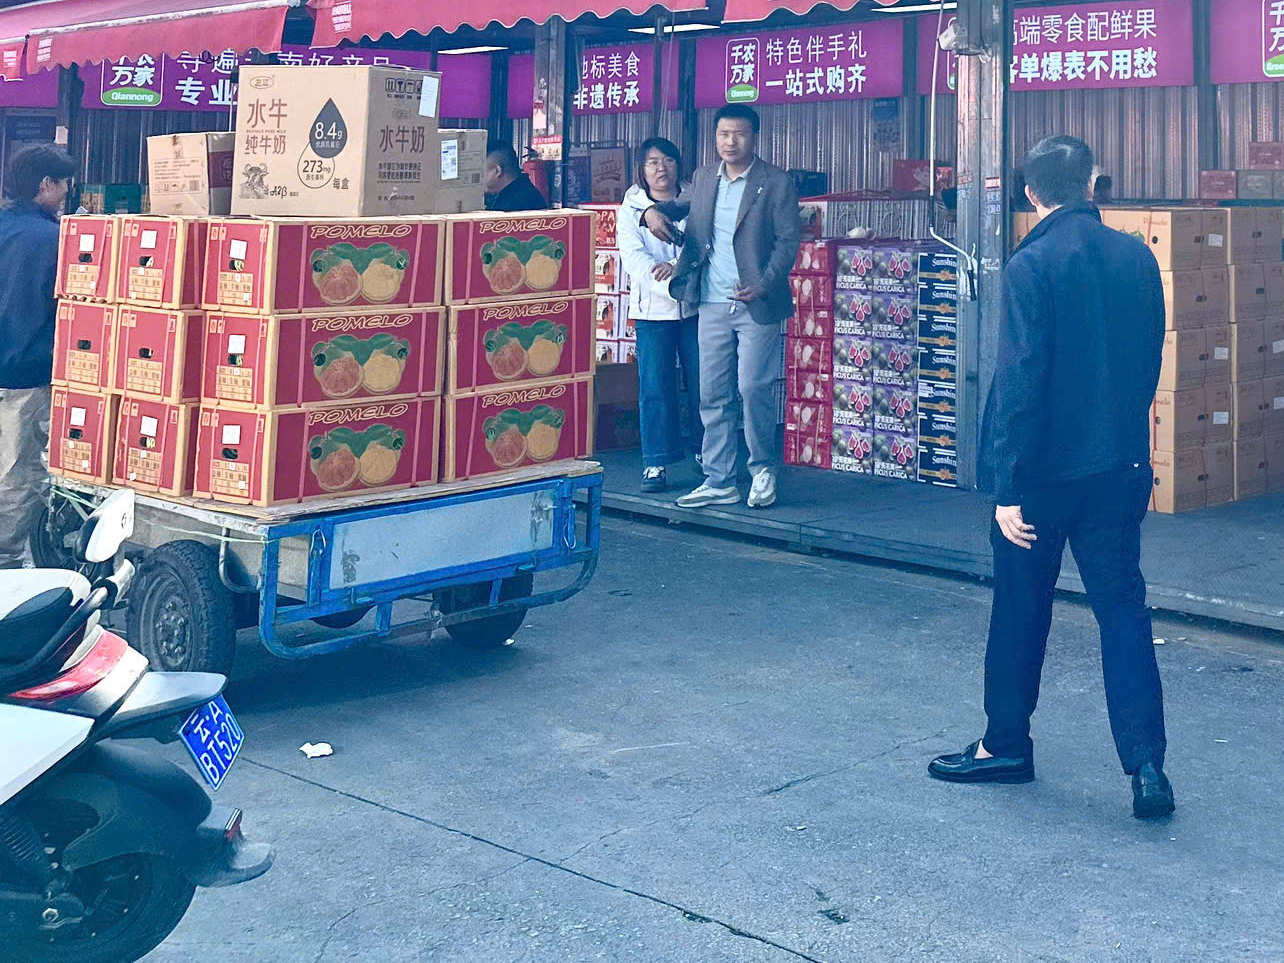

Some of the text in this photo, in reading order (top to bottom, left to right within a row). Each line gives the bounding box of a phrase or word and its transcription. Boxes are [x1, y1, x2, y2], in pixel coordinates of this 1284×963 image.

[1012, 8, 1157, 46] 端零食配鲜果
[731, 43, 755, 63] 千农
[766, 30, 867, 66] 特色伴手礼
[110, 66, 155, 87] 万家
[730, 63, 754, 83] 万家
[766, 63, 866, 96] 一站式购齐
[111, 92, 154, 102] Qiannong
[573, 80, 640, 110] 非遗传承
[247, 98, 288, 129] 水牛
[314, 122, 343, 140] 8.4g
[380, 125, 425, 154] 水牛奶
[245, 135, 286, 155] 纯牛奶
[302, 160, 331, 173] 273mg
[311, 224, 412, 239] POMELO
[479, 217, 567, 234] POMELO
[932, 258, 956, 267] Sunshin
[932, 291, 956, 300] Sunshin
[483, 300, 569, 321] POMELO
[312, 313, 414, 332] POMELO
[931, 323, 956, 333] Sunshin
[932, 356, 956, 365] Sunshin
[482, 384, 566, 408] POMELO
[932, 389, 956, 399] Sunshin
[308, 403, 409, 425] POMELO
[932, 423, 956, 433] Sunshin
[932, 457, 956, 467] Sunshin
[200, 713, 241, 784] BT520
